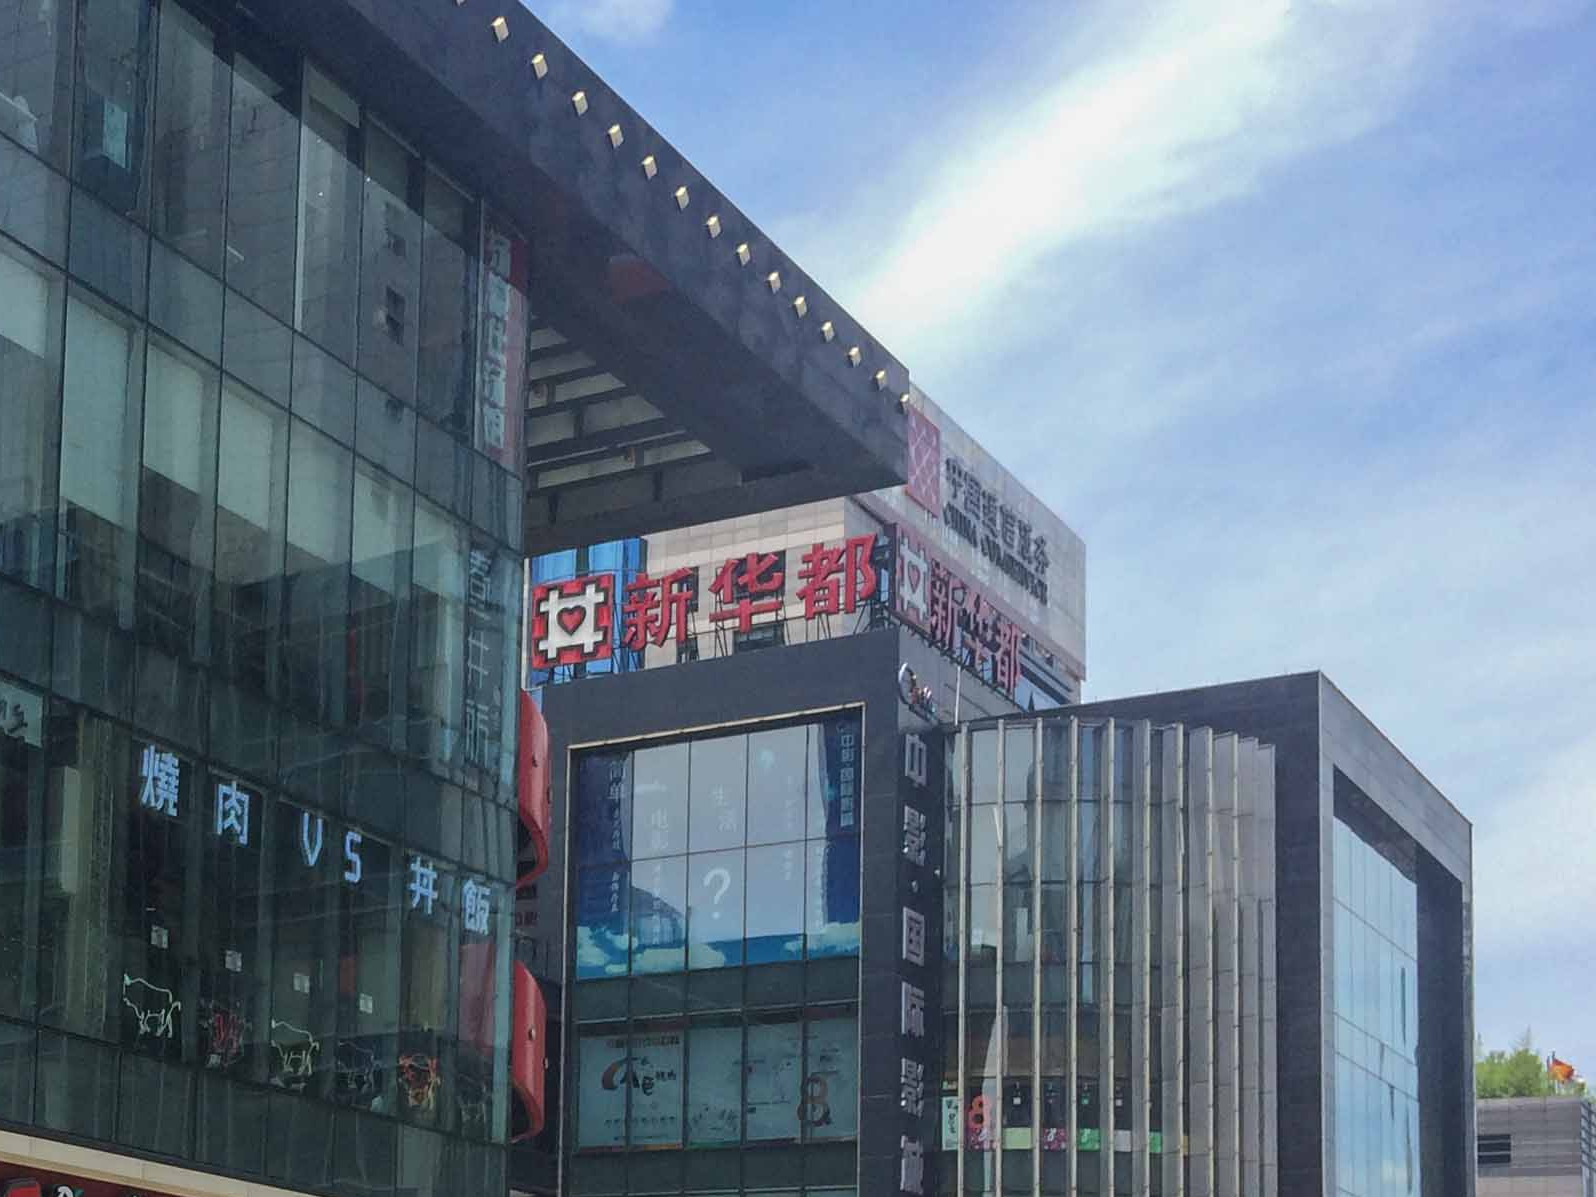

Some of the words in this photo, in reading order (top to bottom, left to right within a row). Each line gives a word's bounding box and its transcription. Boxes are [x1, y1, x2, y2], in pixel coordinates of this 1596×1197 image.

[621, 533, 879, 651] 新华都
[930, 557, 1021, 694] 新华都
[301, 811, 363, 884] VS
